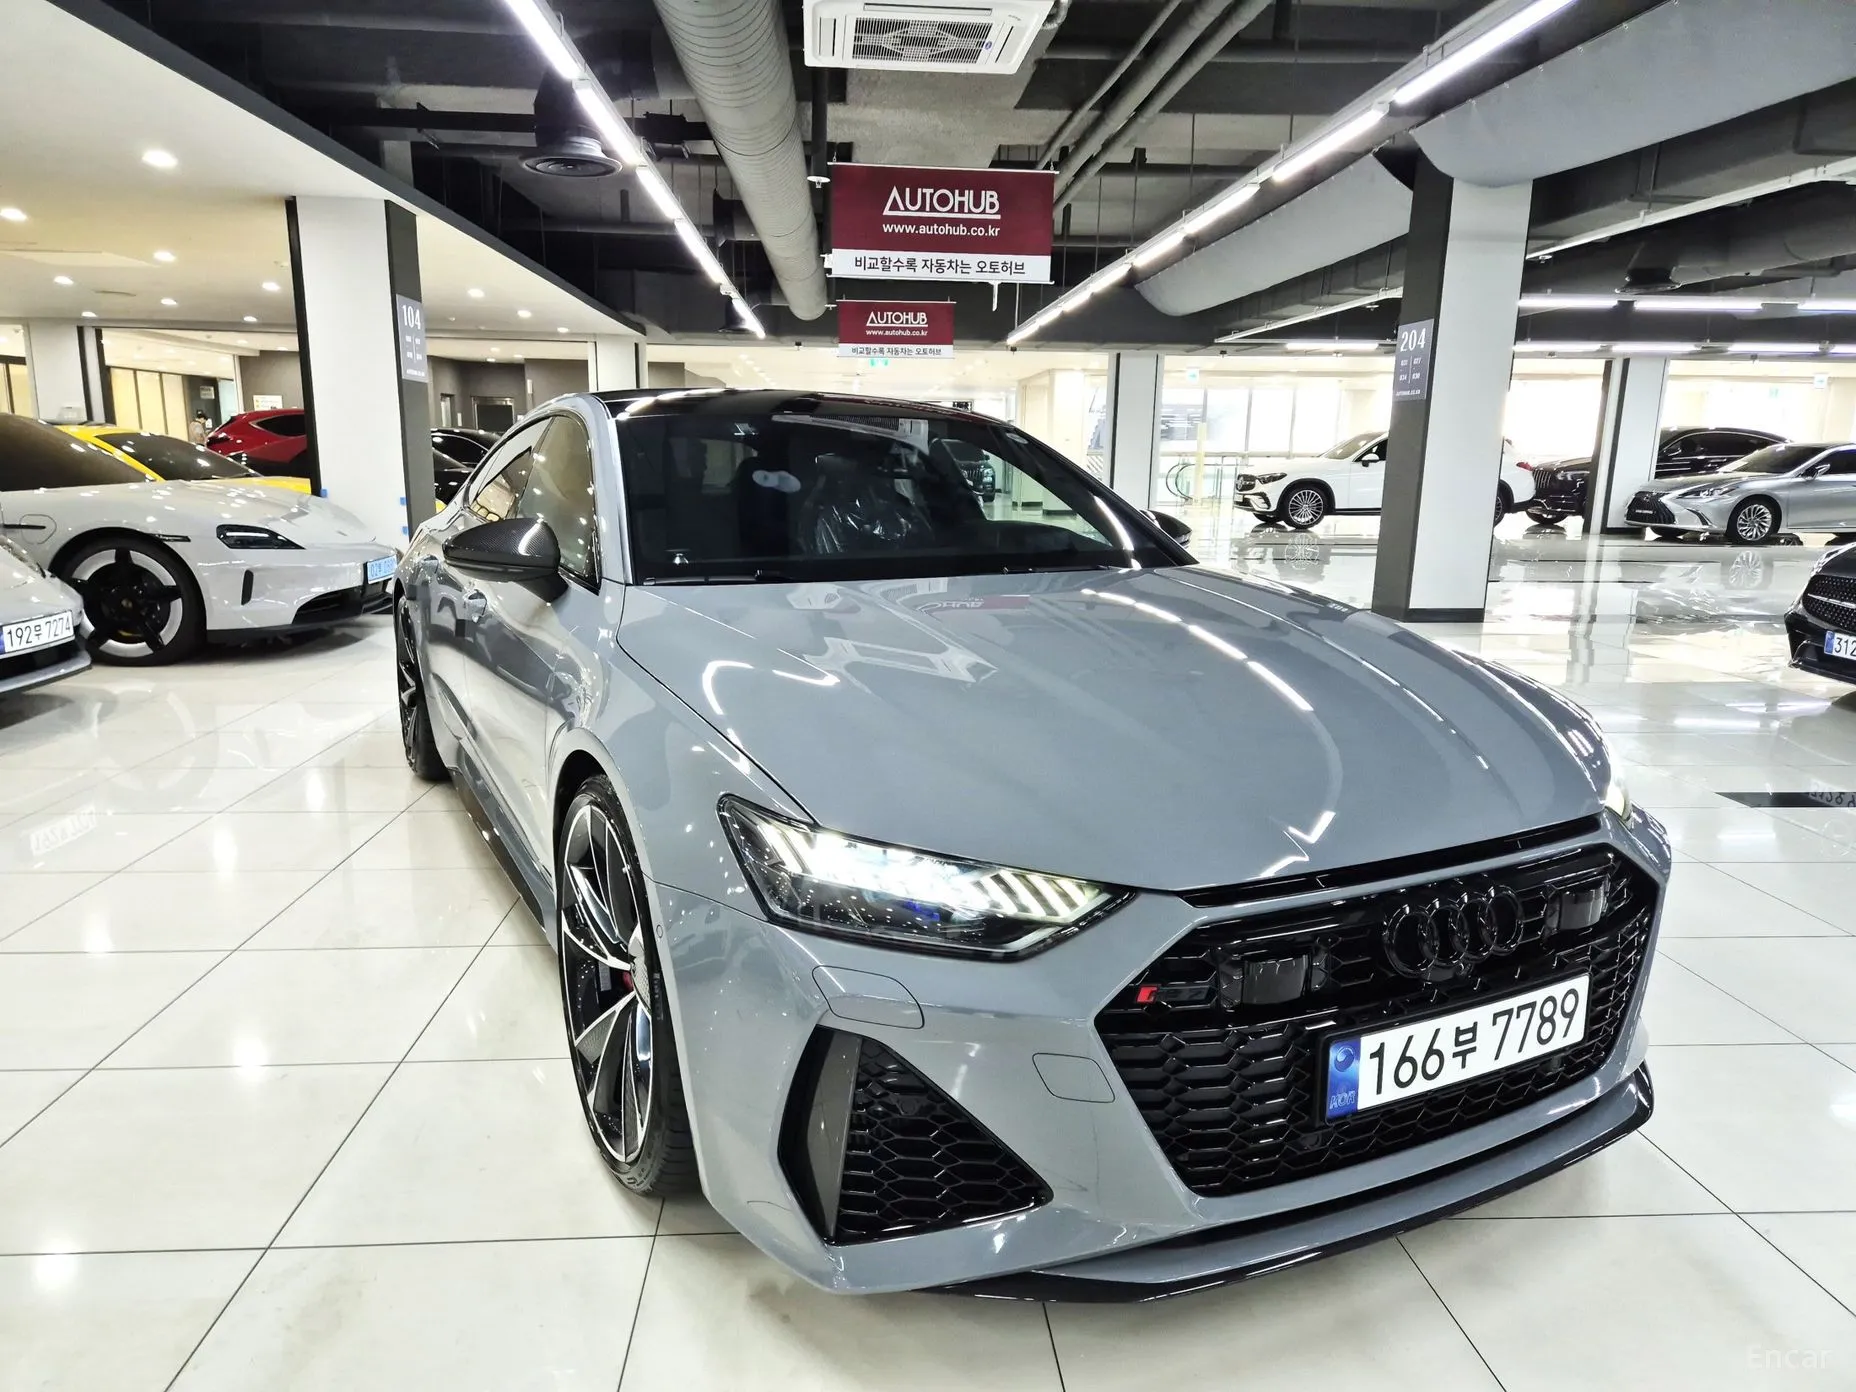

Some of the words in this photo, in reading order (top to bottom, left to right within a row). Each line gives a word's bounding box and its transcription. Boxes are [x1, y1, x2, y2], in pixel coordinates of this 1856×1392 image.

[883, 185, 1001, 219] AUTOHUB
[882, 223, 1001, 237] www.autohub.co.kr
[854, 256, 918, 273] 비교할수록
[921, 258, 972, 275] 자동차는
[975, 260, 1026, 276] 오토허브
[402, 304, 421, 330] 104
[865, 311, 929, 327] AUTOHUB
[865, 329, 929, 337] www.autohub.co.kr
[1400, 327, 1427, 352] 204
[851, 346, 885, 356] 비교할수록
[886, 347, 913, 356] 자동차는
[915, 347, 942, 356] 오토허브
[7, 624, 42, 647] 192무
[45, 616, 71, 639] 7274
[1369, 1021, 1478, 1095] 166부
[1492, 988, 1580, 1061] 7789
